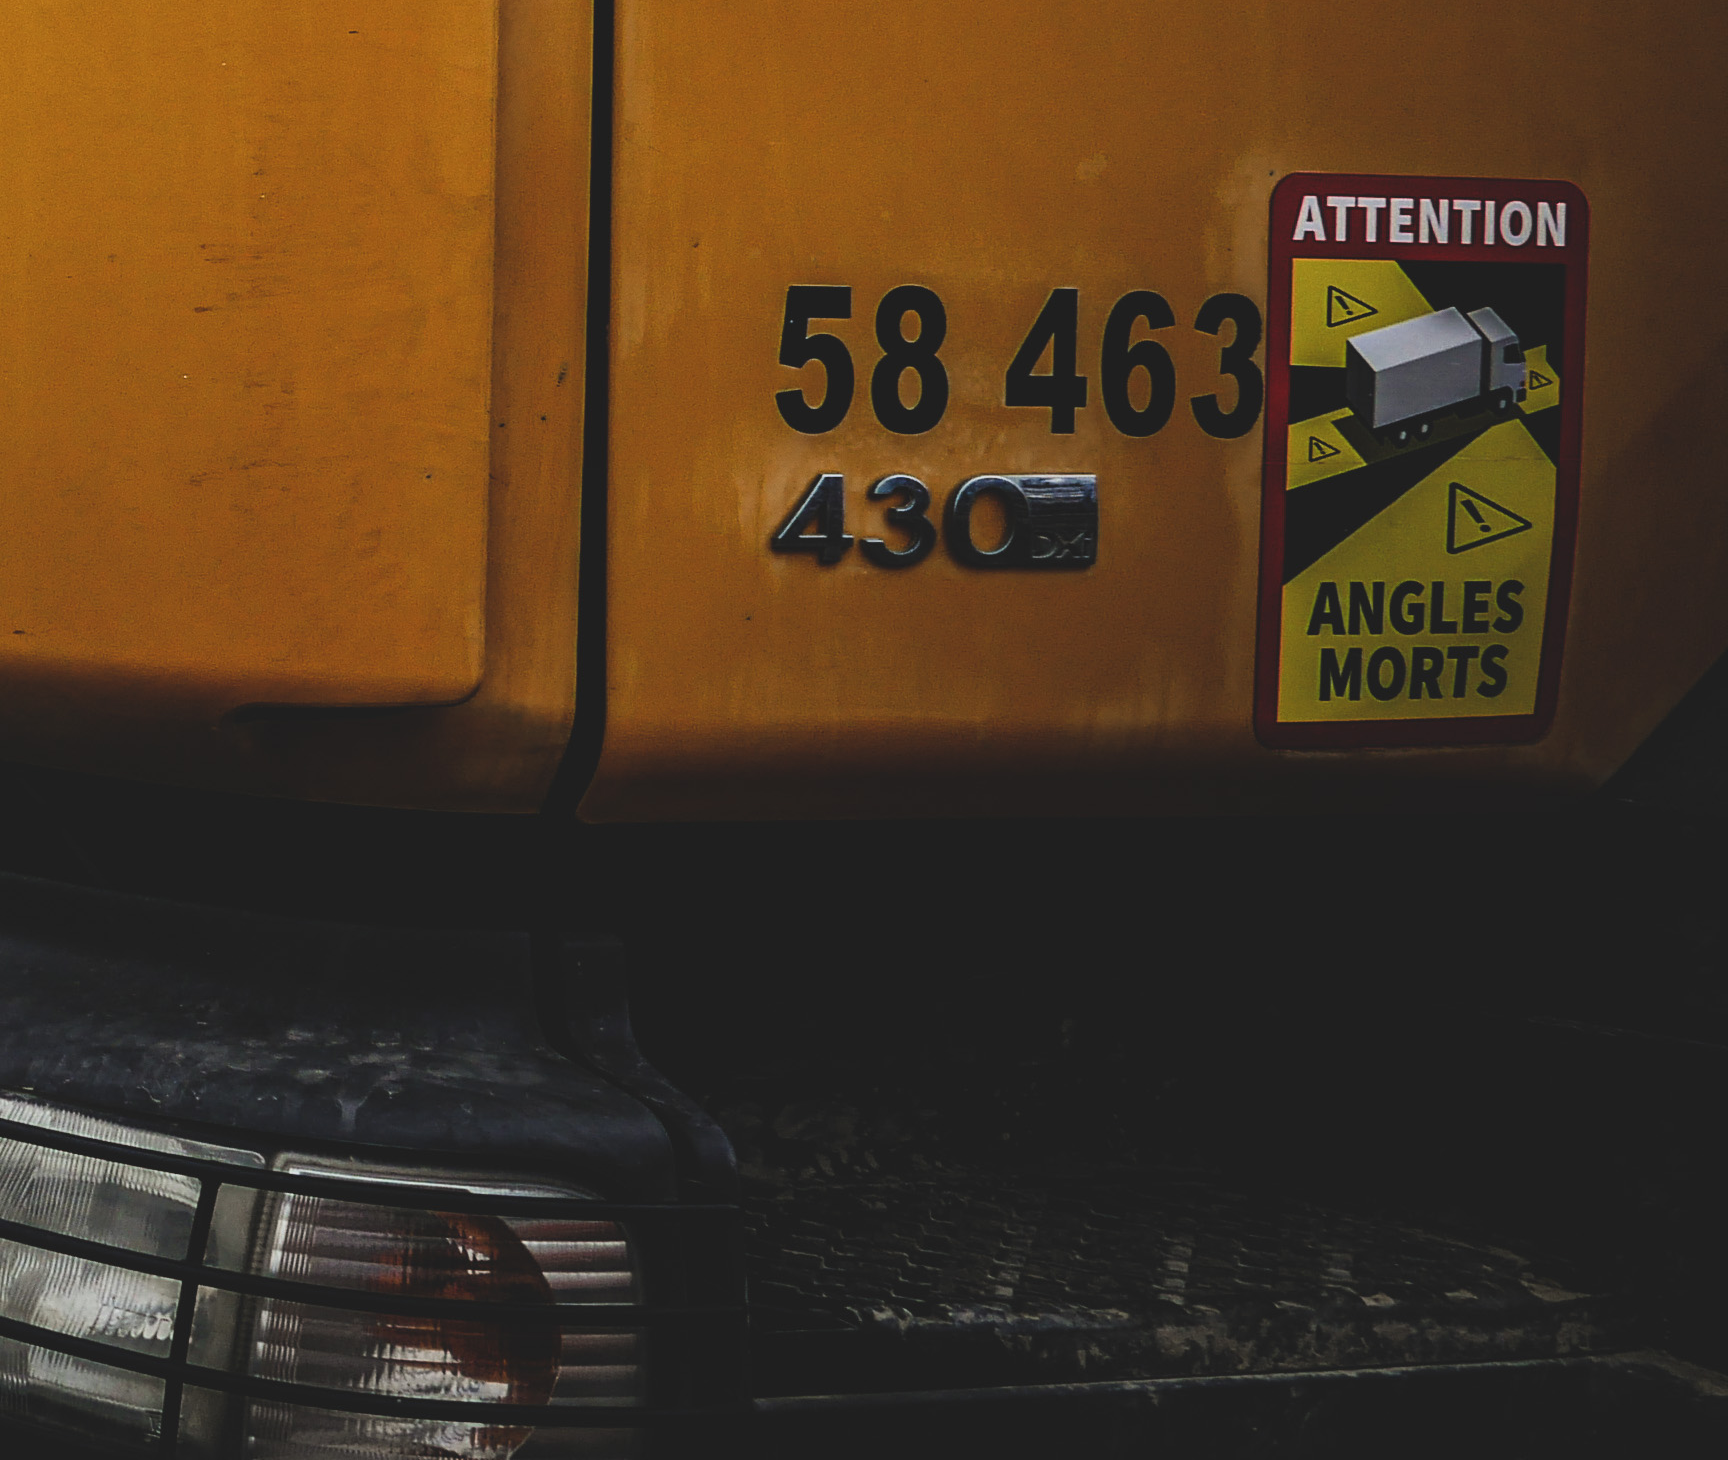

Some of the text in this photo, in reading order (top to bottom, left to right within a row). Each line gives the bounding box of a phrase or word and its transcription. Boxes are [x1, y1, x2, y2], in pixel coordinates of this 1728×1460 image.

[1292, 193, 1569, 249] ATTENTION
[773, 282, 1266, 440] 58 463
[770, 471, 1032, 569] 430
[1306, 577, 1527, 639] ANGLES
[1317, 642, 1511, 703] MORTS
